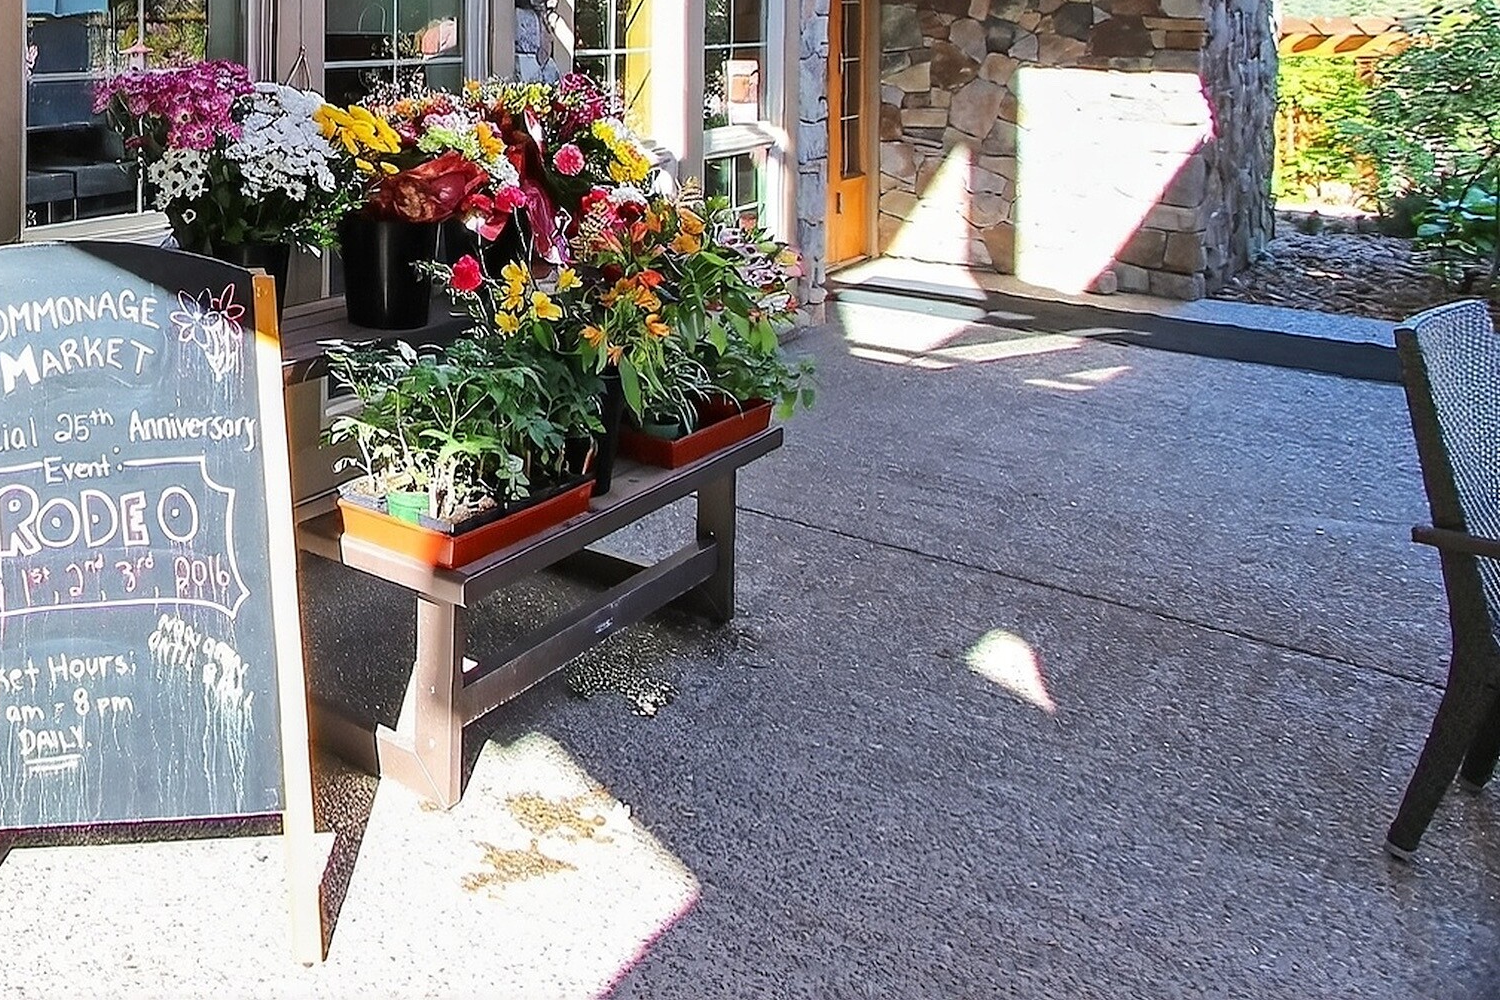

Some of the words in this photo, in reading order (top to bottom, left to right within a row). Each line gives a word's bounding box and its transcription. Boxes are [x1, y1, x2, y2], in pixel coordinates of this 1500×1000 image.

[0, 336, 156, 397] MARKET
[54, 407, 115, 442] 25th
[128, 409, 256, 452] Anniversary
[174, 554, 231, 602] 2016
